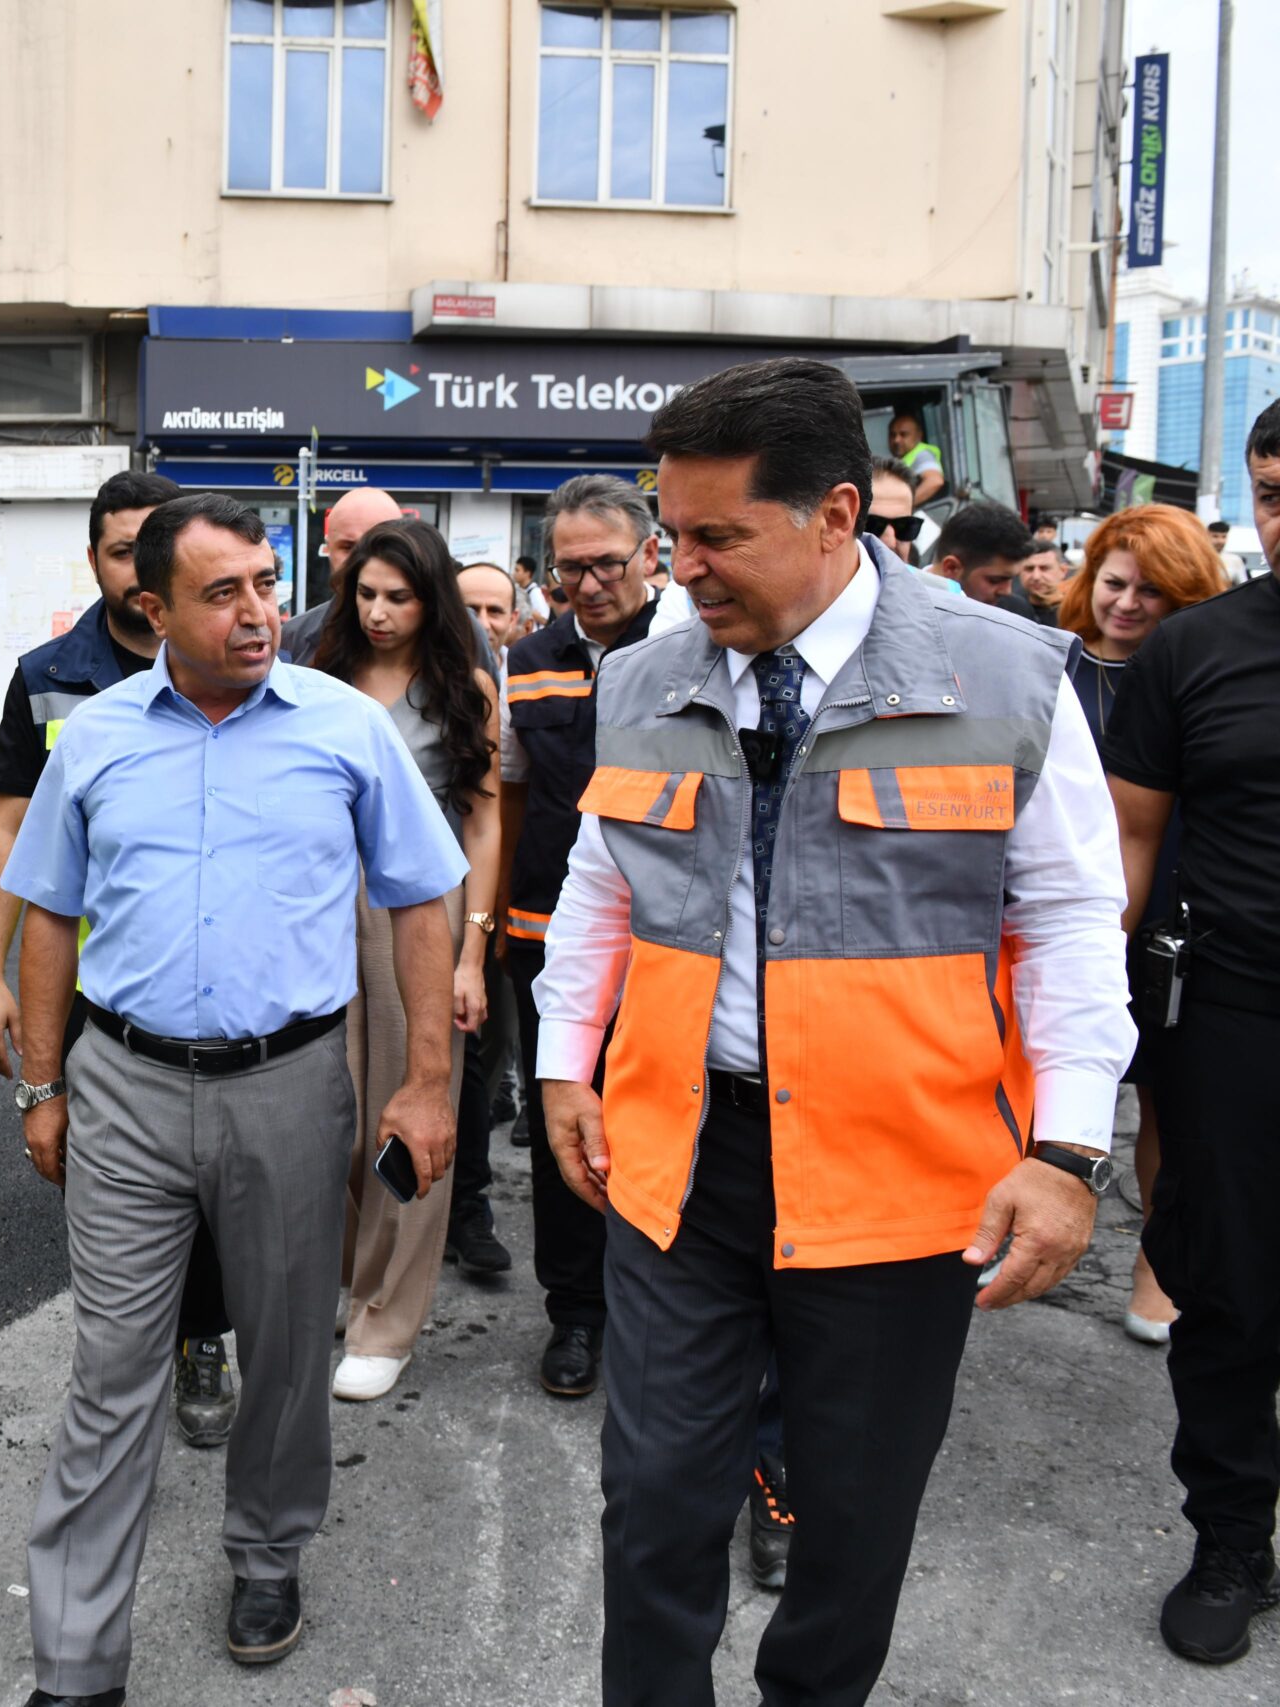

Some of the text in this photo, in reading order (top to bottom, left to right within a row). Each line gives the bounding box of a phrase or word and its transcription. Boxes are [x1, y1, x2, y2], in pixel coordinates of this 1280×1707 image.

[1142, 63, 1161, 121] KURS
[428, 373, 519, 408] Türk
[162, 407, 221, 429] AKTÜRK
[916, 800, 1007, 819] ESENYURT
